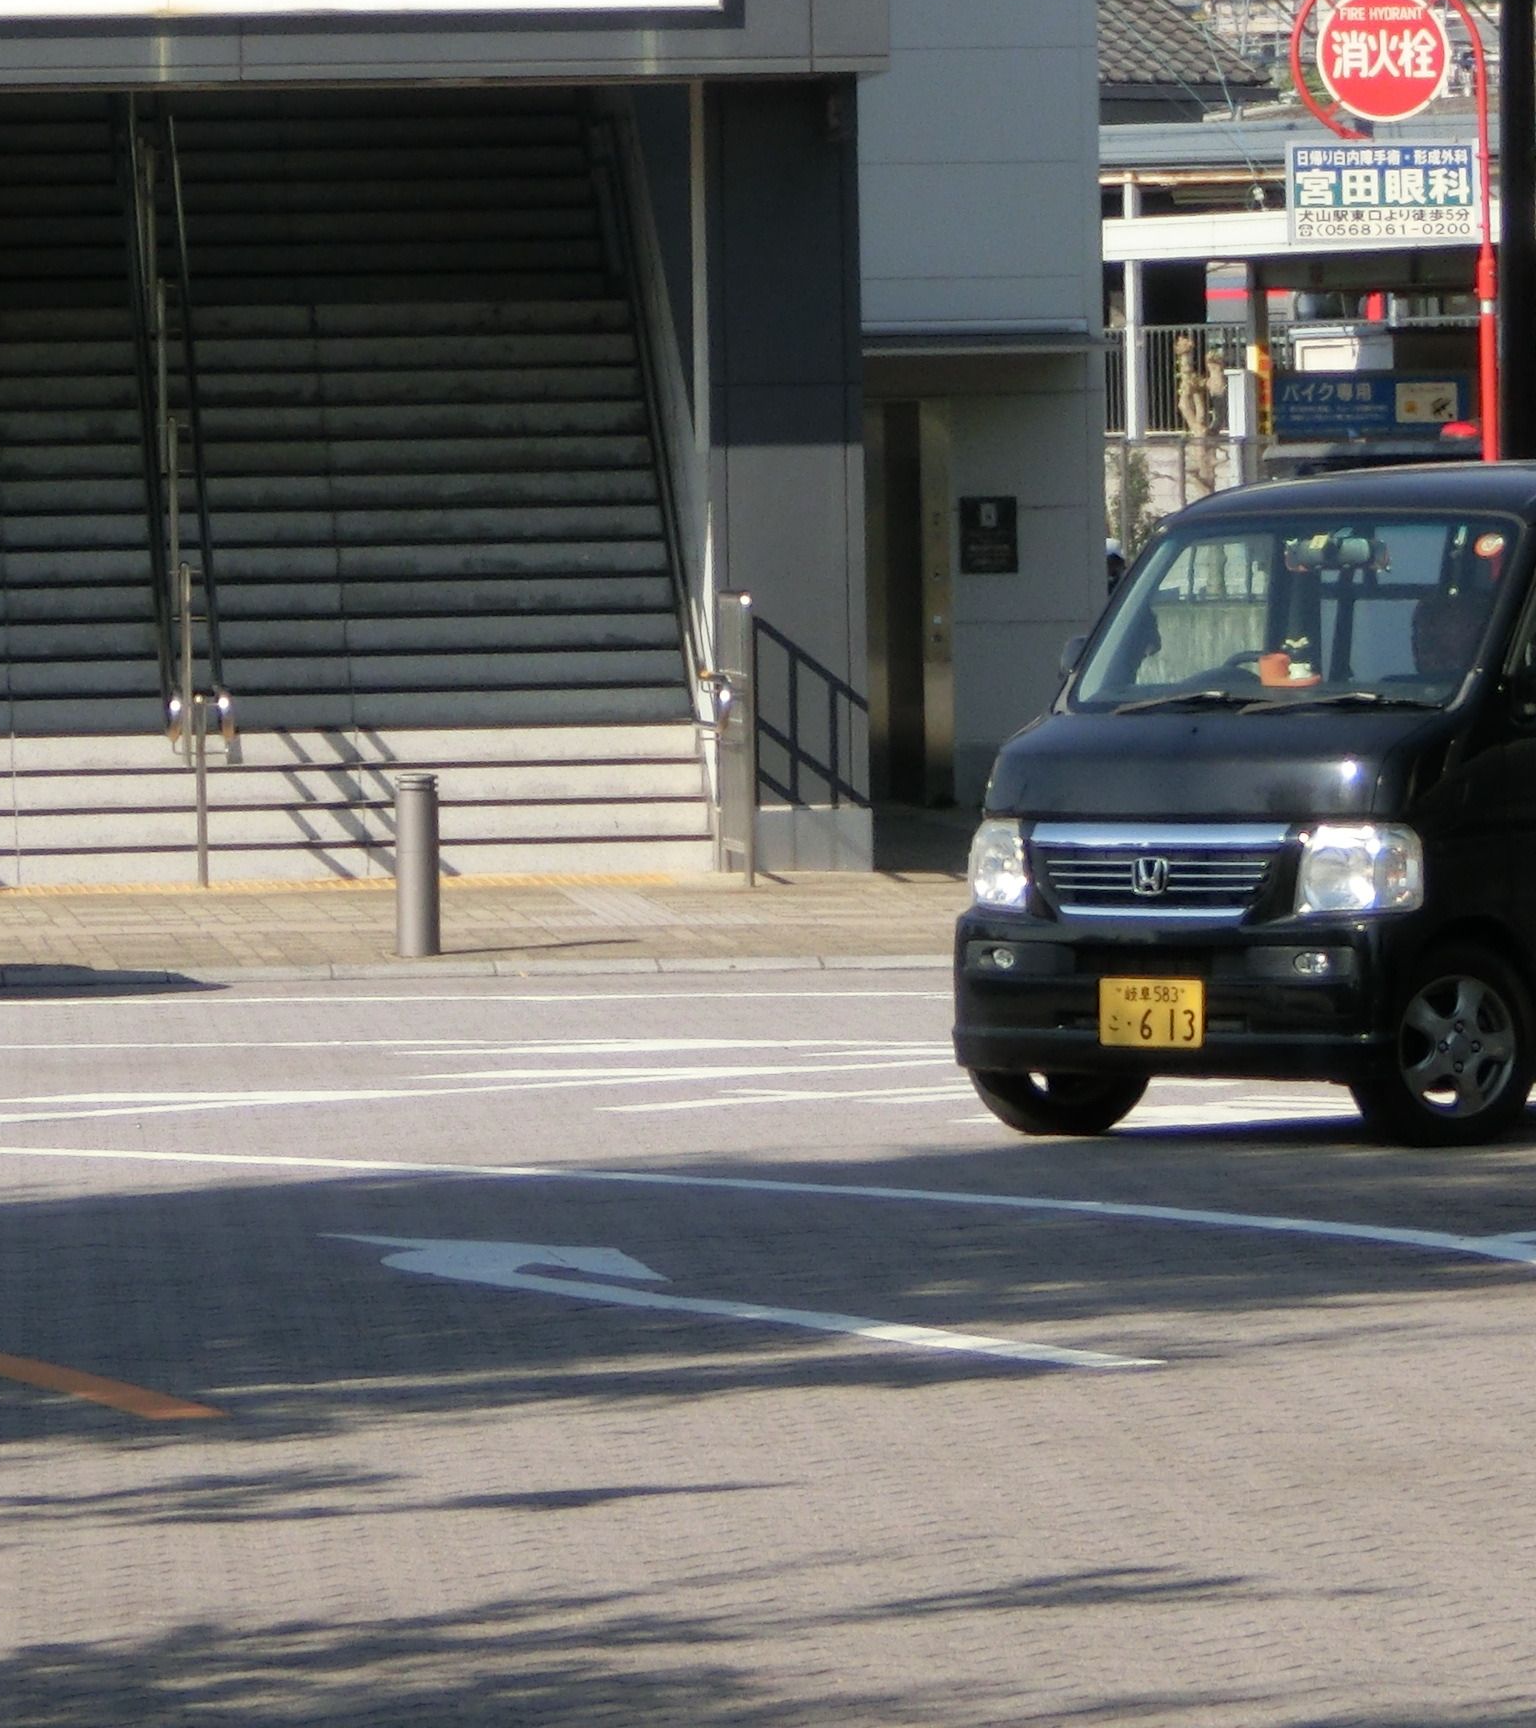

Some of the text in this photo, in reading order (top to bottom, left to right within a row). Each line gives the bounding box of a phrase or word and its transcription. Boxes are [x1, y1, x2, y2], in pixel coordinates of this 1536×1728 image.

[1340, 5, 1424, 21] FIRE HYDRANT
[1331, 28, 1437, 79] 消火栓
[1296, 167, 1470, 206] 宮田眼科
